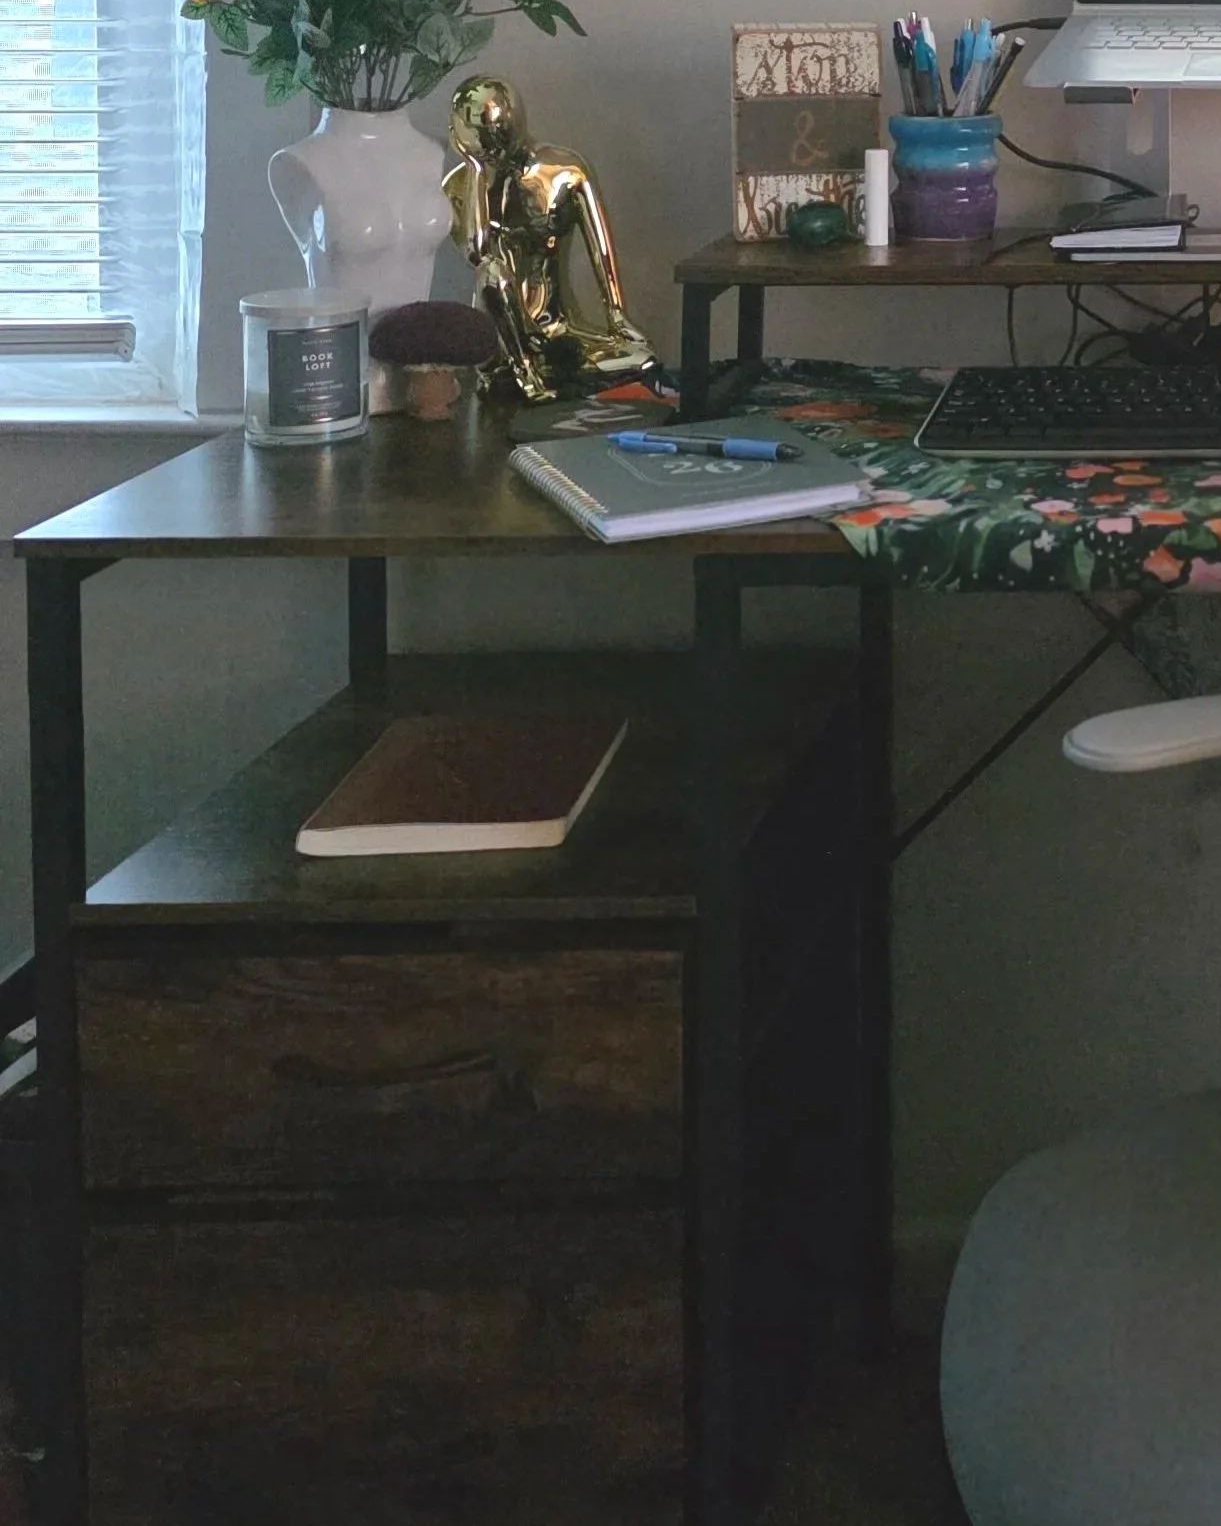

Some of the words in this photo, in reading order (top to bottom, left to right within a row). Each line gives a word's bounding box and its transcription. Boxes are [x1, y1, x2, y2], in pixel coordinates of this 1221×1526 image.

[790, 110, 829, 167] &
[302, 352, 333, 362] BOOK
[306, 361, 330, 370] LOFT
